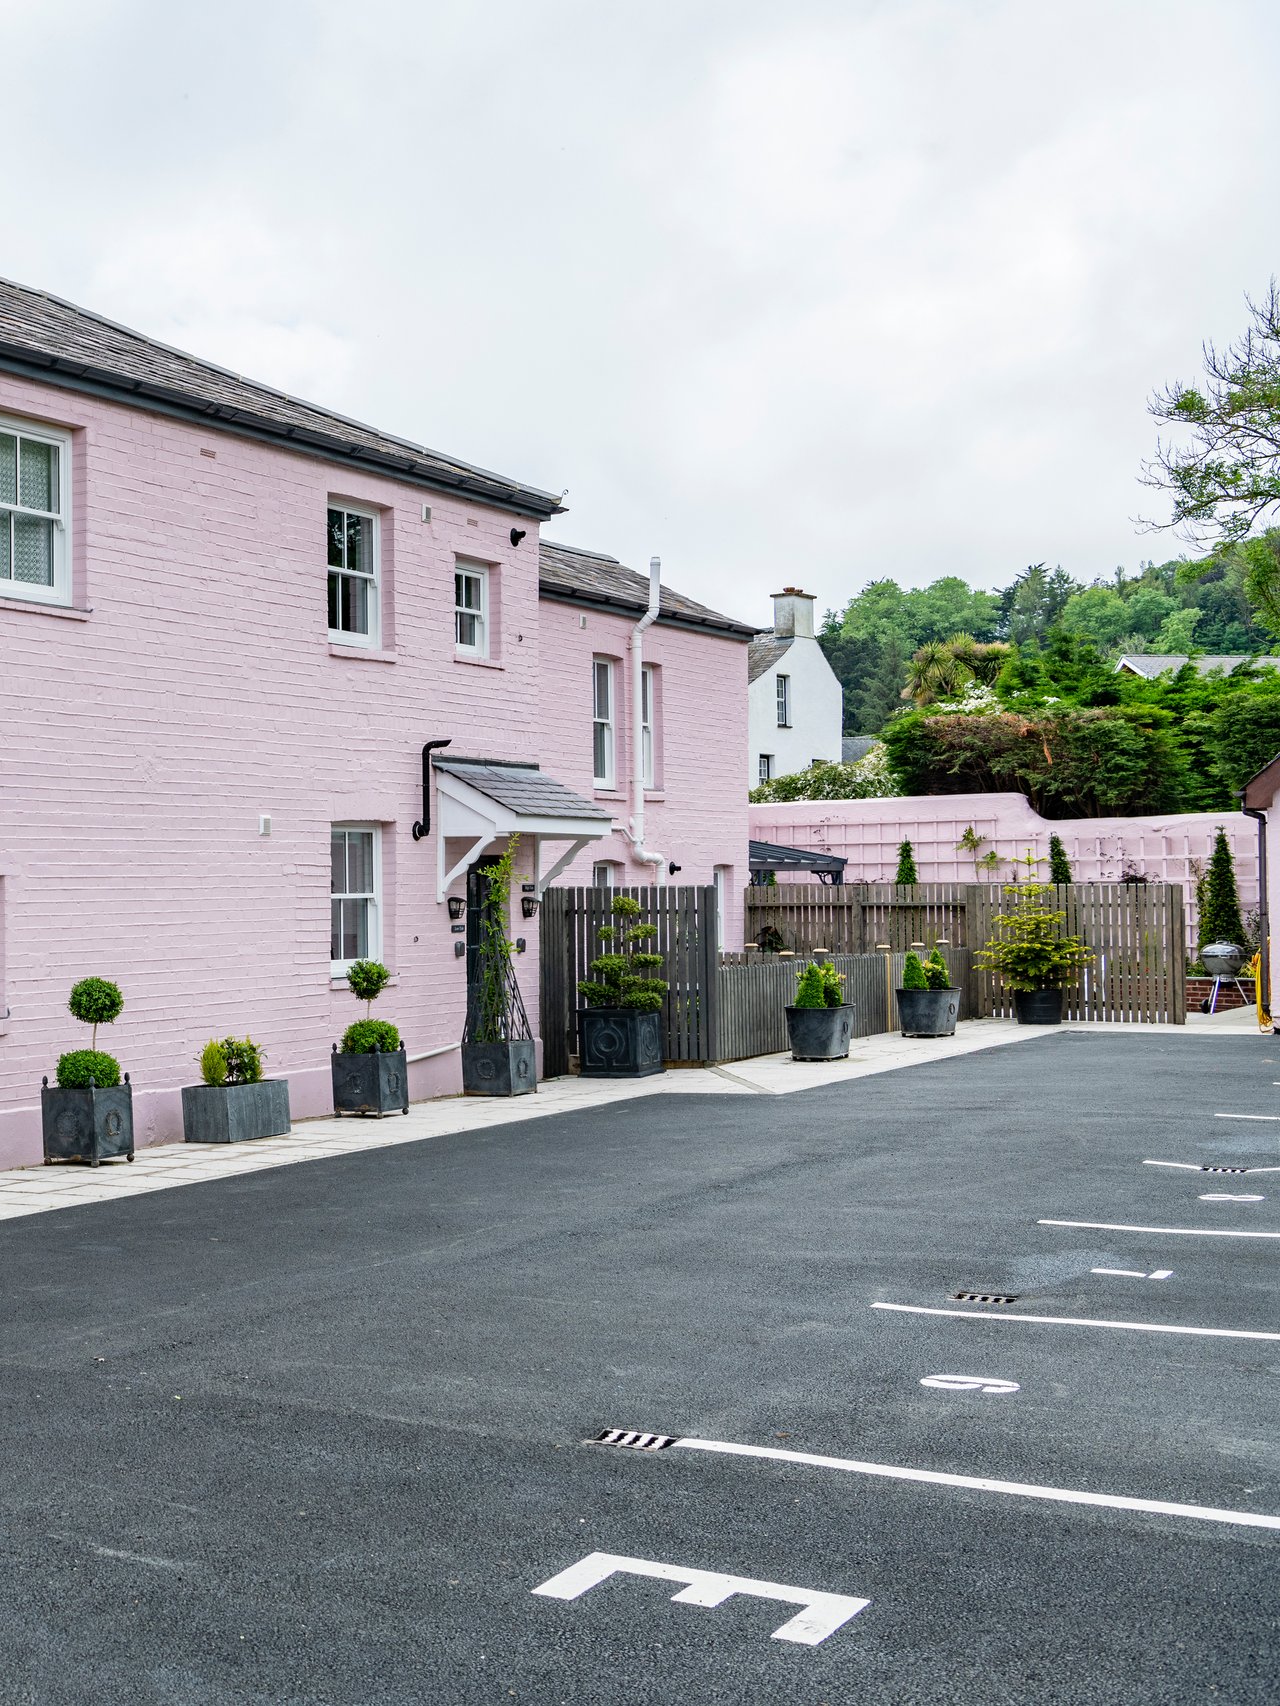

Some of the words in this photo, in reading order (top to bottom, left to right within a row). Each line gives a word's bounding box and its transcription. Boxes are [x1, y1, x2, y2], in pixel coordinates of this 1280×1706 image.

[1197, 1193, 1266, 1202] 8
[1090, 1268, 1174, 1280] 7
[531, 1551, 871, 1646] E
